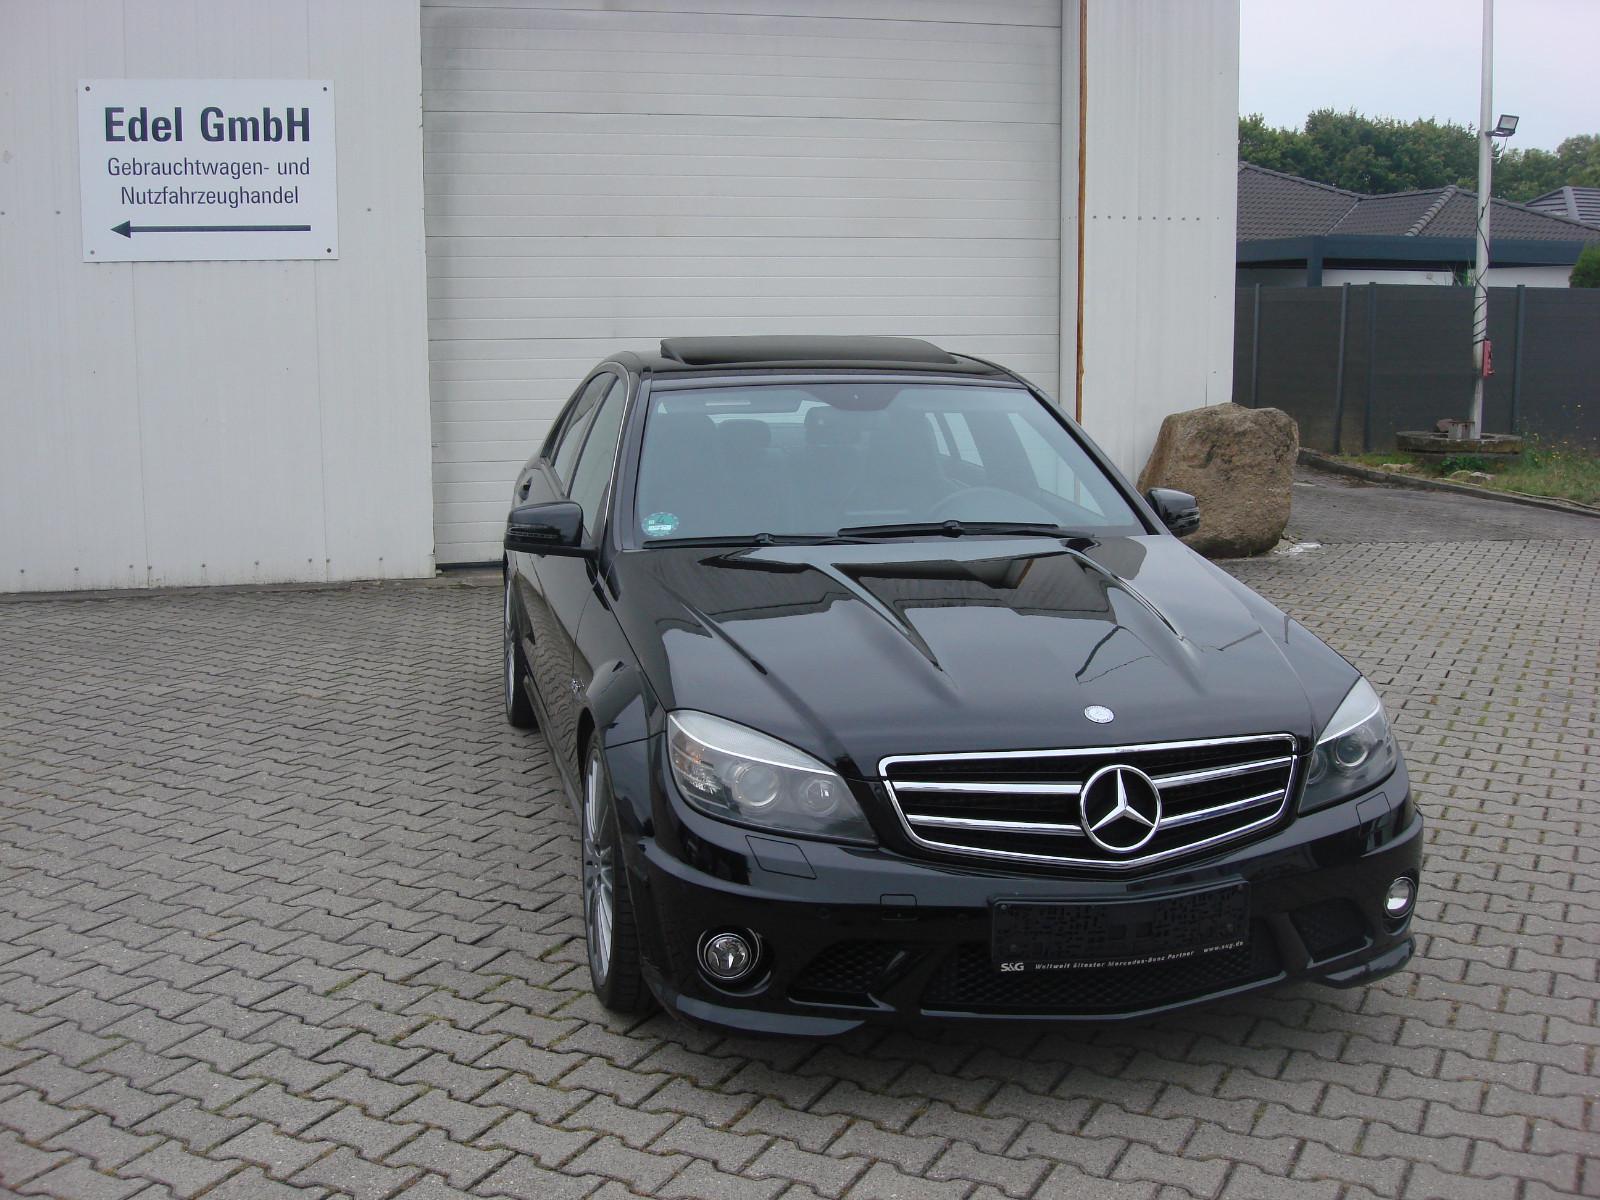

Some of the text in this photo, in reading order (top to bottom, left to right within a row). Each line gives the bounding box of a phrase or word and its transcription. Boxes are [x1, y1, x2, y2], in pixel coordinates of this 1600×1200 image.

[105, 106, 310, 142] Edel GmbH
[107, 157, 311, 179] Gebrauchtwagen- und
[121, 186, 299, 208] Nutzfahrzeughandel
[1000, 962, 1025, 972] S&G
[1167, 950, 1194, 960] Partner
